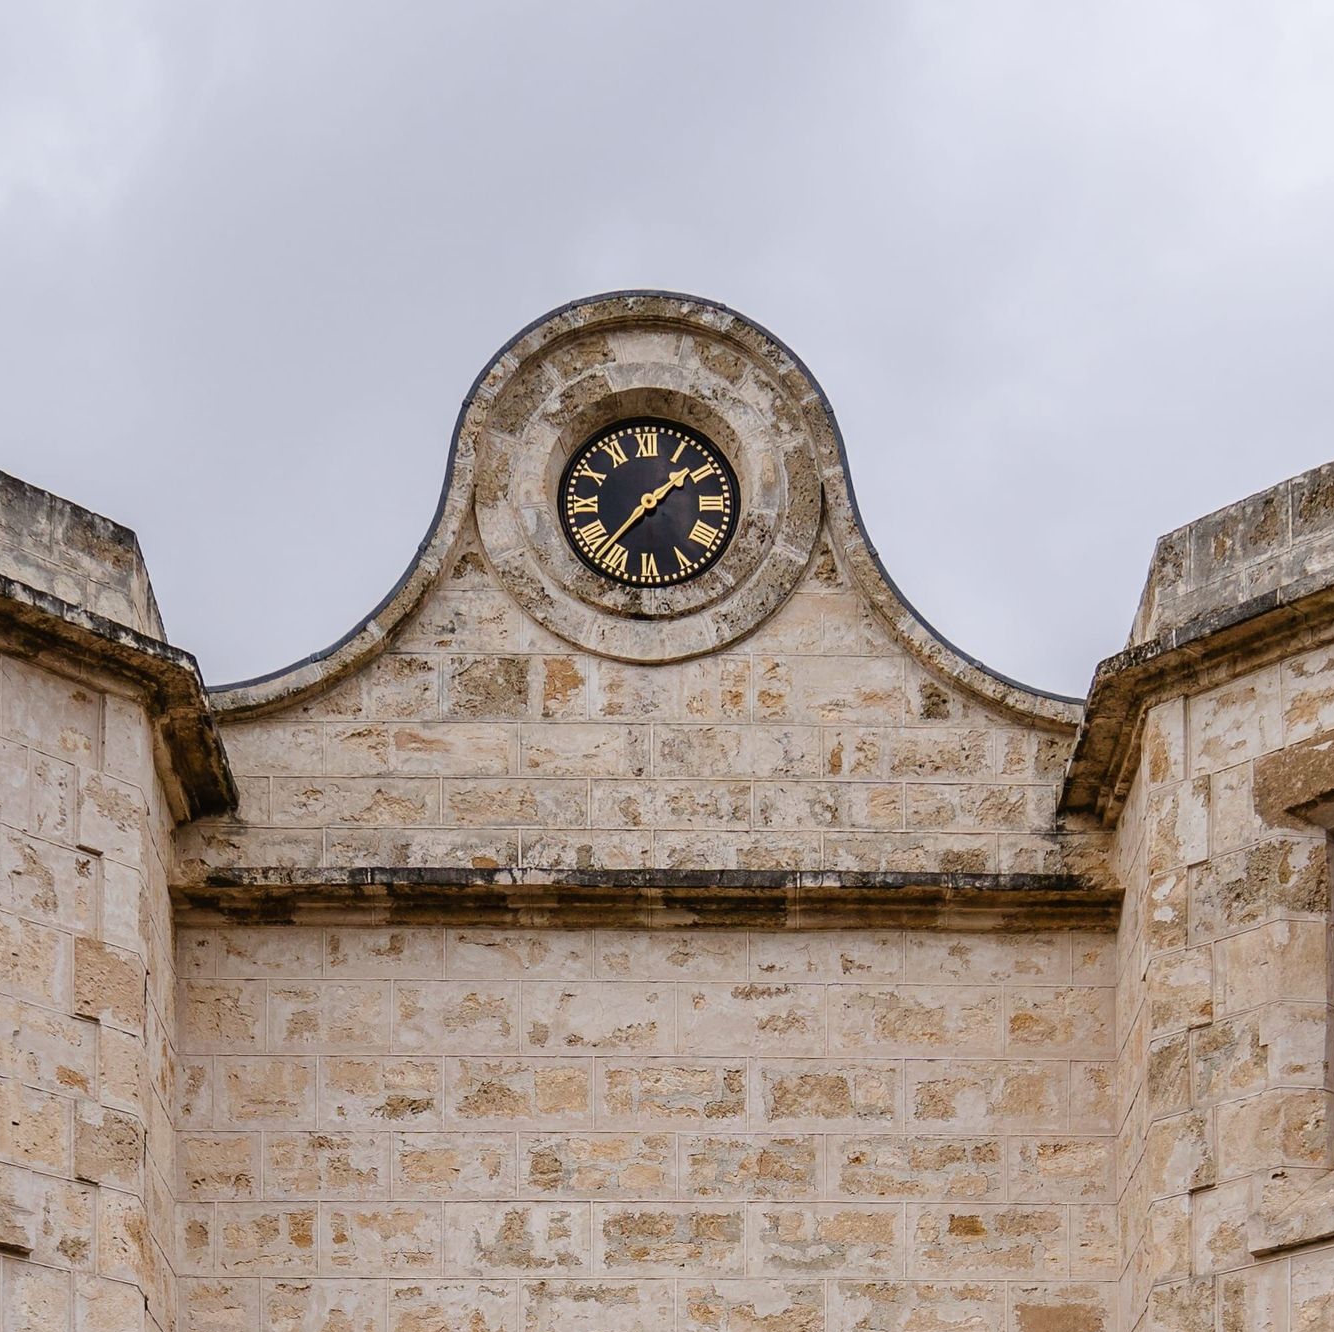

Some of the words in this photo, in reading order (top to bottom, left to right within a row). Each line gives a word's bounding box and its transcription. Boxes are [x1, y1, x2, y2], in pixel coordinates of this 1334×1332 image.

[602, 440, 629, 468] XI
[635, 433, 659, 458] XII
[670, 440, 688, 463] I
[580, 464, 607, 487] X
[689, 462, 715, 484] II
[574, 495, 598, 513] IX
[699, 495, 724, 512] III
[579, 519, 609, 552] VIII
[688, 519, 719, 548] IIII
[602, 543, 629, 573] VII
[641, 553, 659, 576] VI
[674, 546, 692, 569] V
